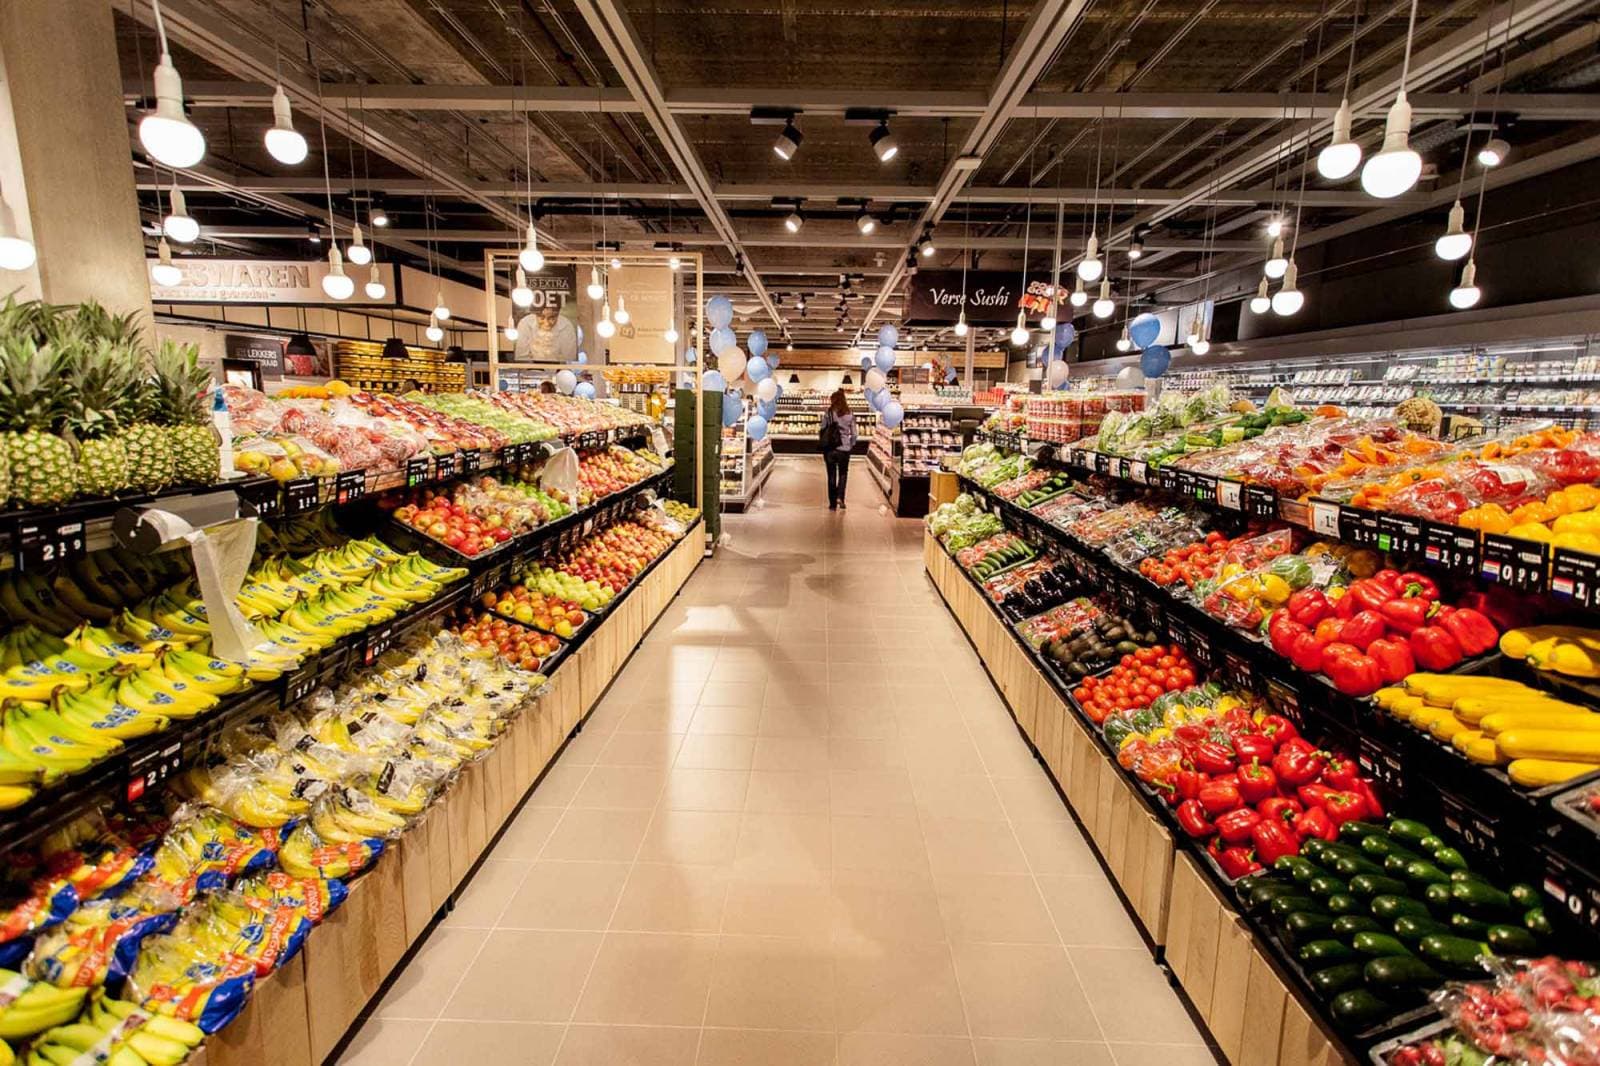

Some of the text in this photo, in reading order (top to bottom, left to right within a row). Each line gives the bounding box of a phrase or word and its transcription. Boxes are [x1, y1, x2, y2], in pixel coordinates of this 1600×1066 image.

[175, 263, 310, 289] ESWAREN
[539, 279, 569, 288] EXTRA
[533, 290, 570, 308] OET
[929, 288, 966, 305] Verse
[970, 286, 1010, 306] Sushi
